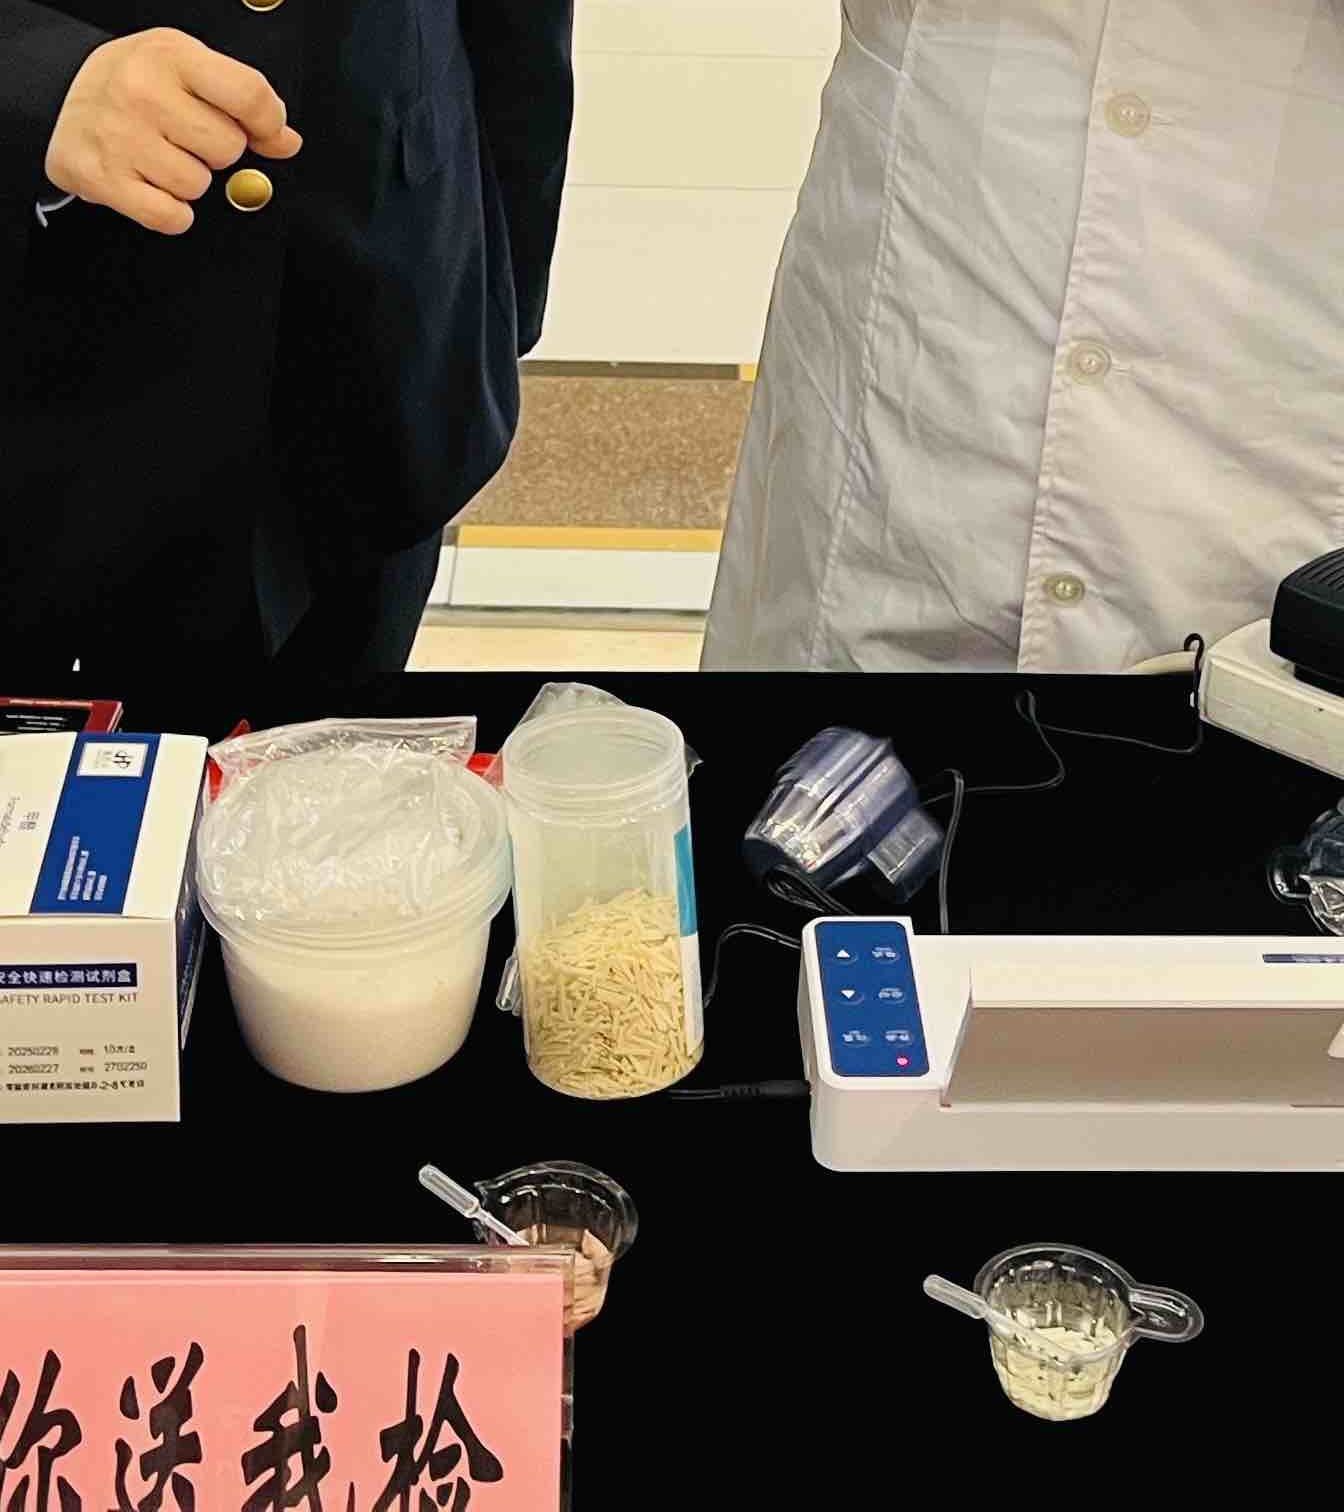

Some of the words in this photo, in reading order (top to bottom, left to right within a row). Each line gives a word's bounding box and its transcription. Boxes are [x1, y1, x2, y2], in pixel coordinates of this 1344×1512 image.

[43, 993, 81, 1005] RAPID
[85, 992, 115, 1004] TEST
[119, 991, 138, 1003] KIT
